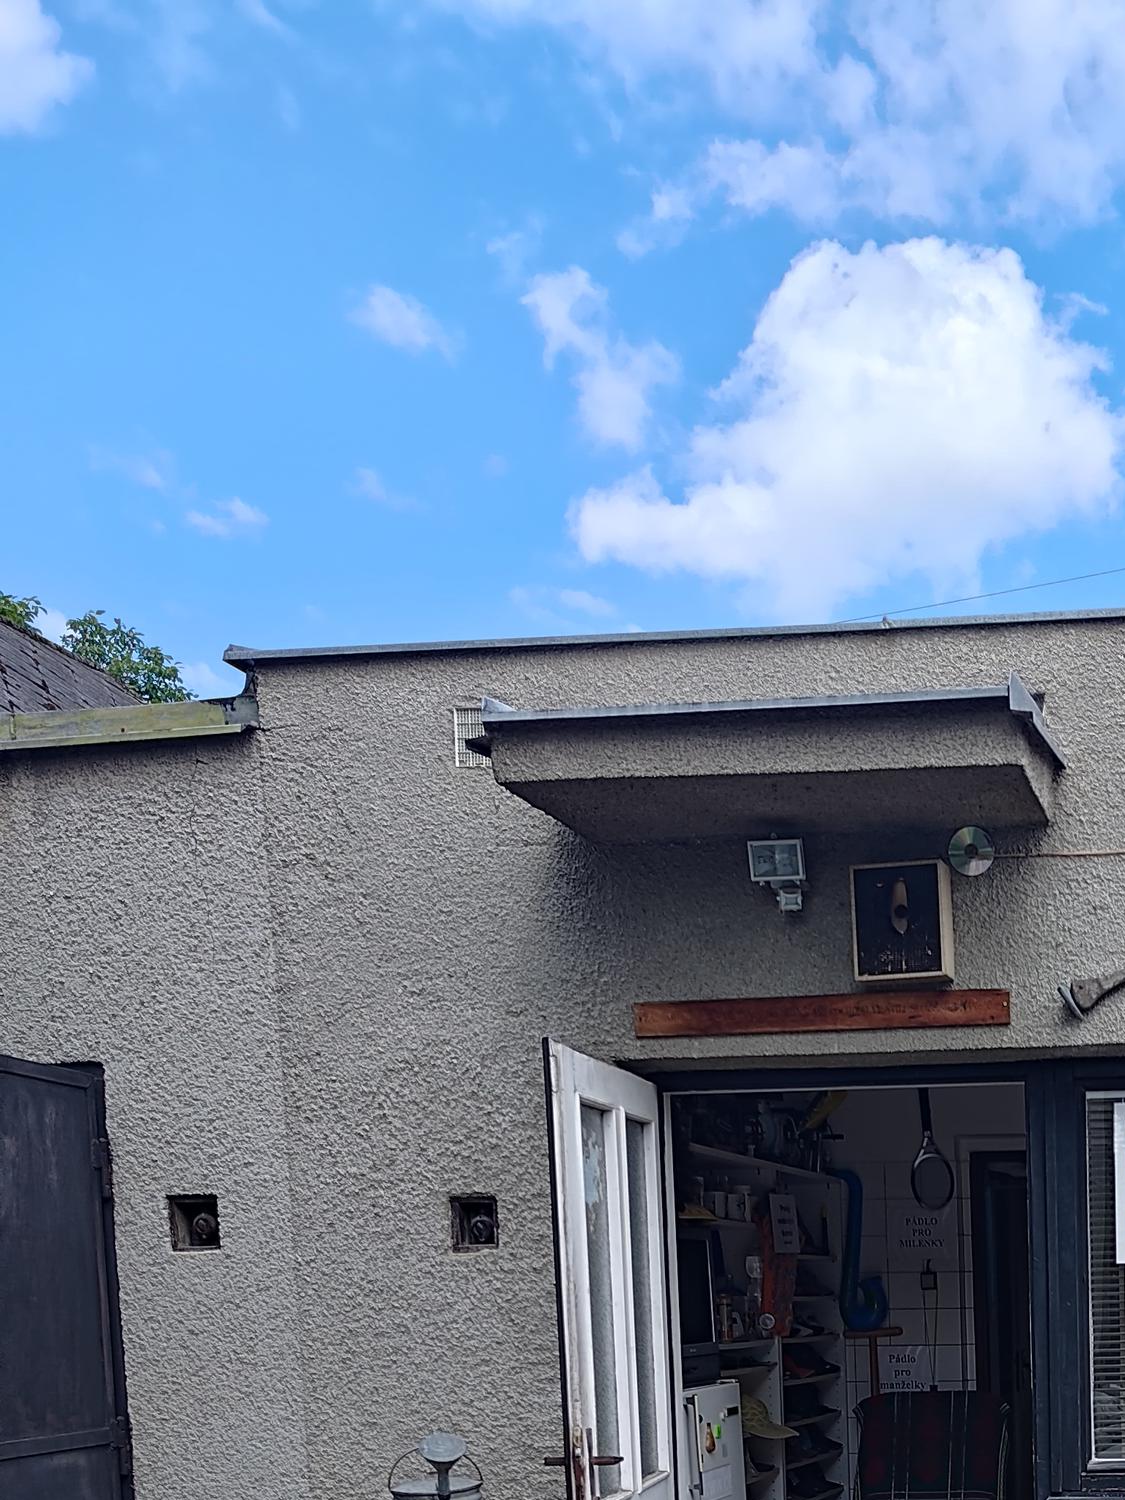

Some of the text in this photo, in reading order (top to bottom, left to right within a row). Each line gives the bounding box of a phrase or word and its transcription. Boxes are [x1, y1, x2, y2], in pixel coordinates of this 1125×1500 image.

[905, 1216, 938, 1226] PÁDLO
[912, 1228, 931, 1237] PRO
[898, 1239, 944, 1248] MILENKY
[889, 1354, 916, 1363] Pádlo
[894, 1369, 911, 1378] pro
[880, 1380, 926, 1391] manželky
